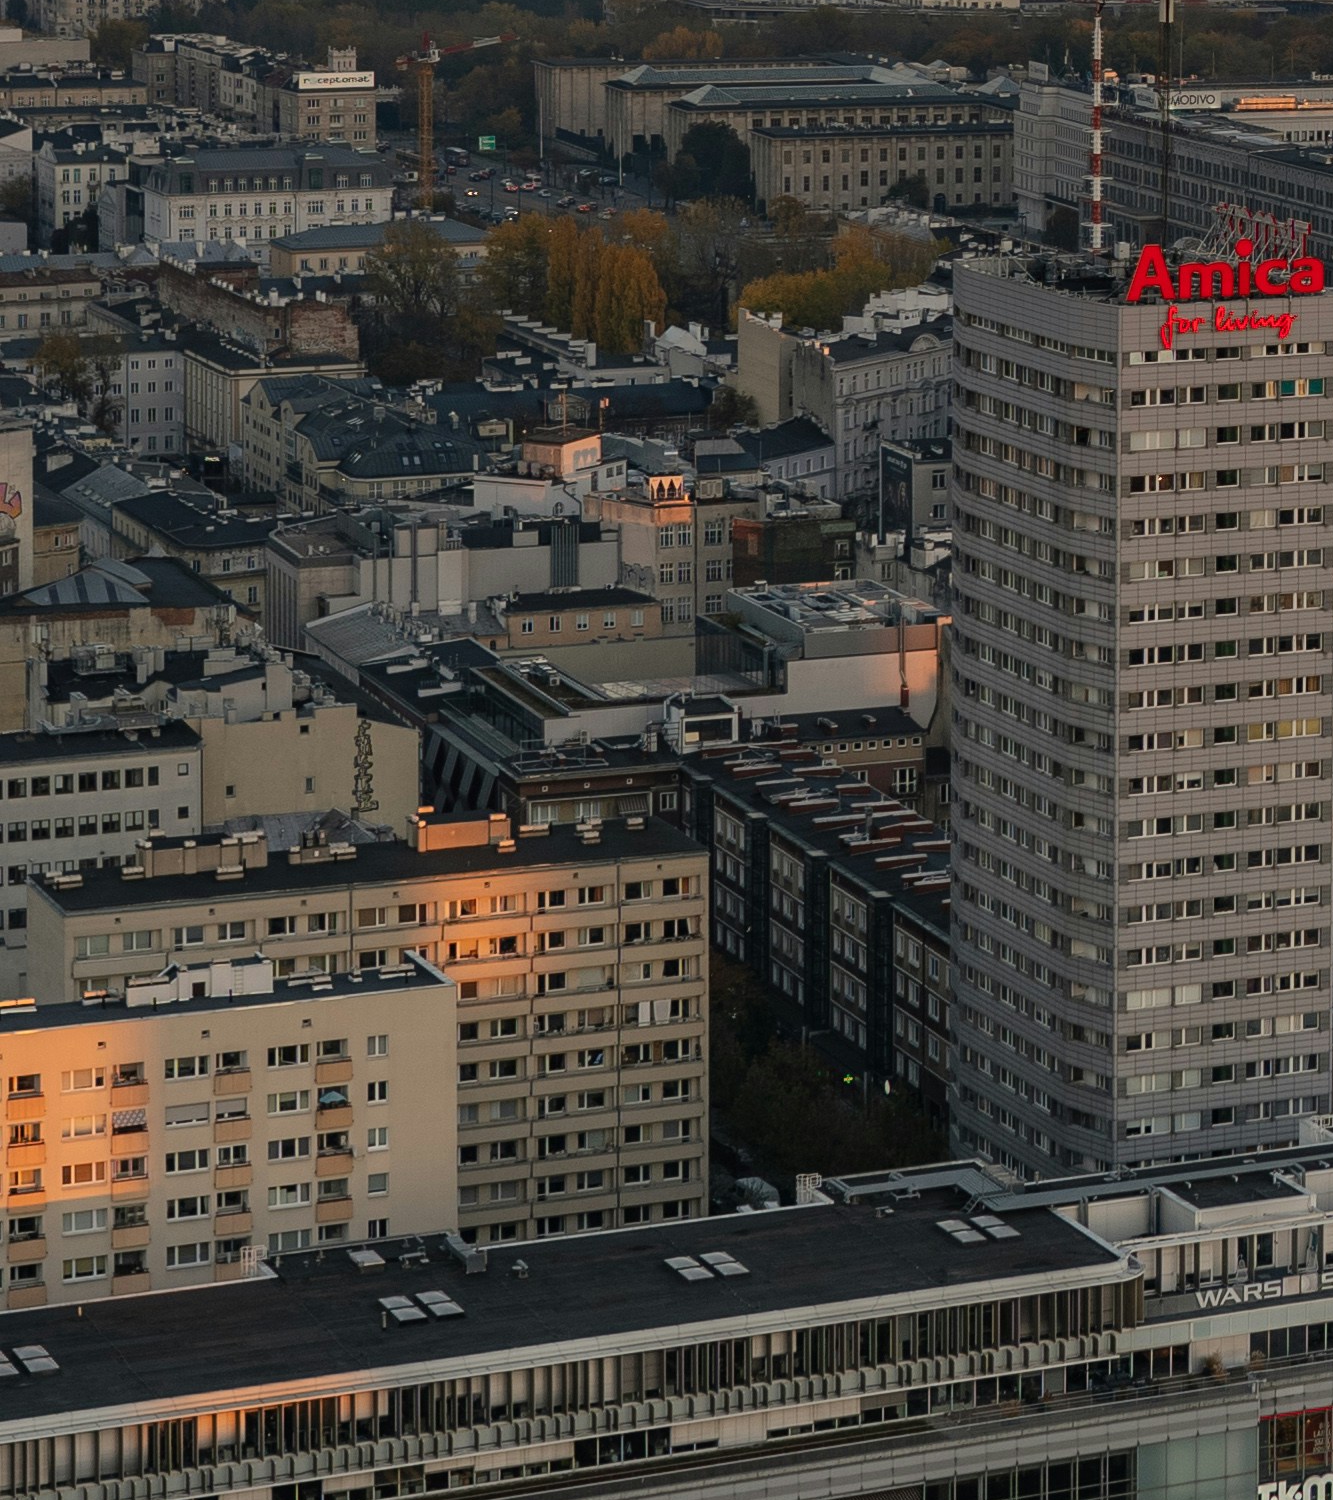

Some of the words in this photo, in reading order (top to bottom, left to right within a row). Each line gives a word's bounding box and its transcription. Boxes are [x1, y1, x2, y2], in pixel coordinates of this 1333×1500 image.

[1126, 238, 1325, 302] Amica
[1161, 305, 1205, 350] for
[1215, 305, 1297, 339] living
[1195, 1279, 1282, 1308] WARS
